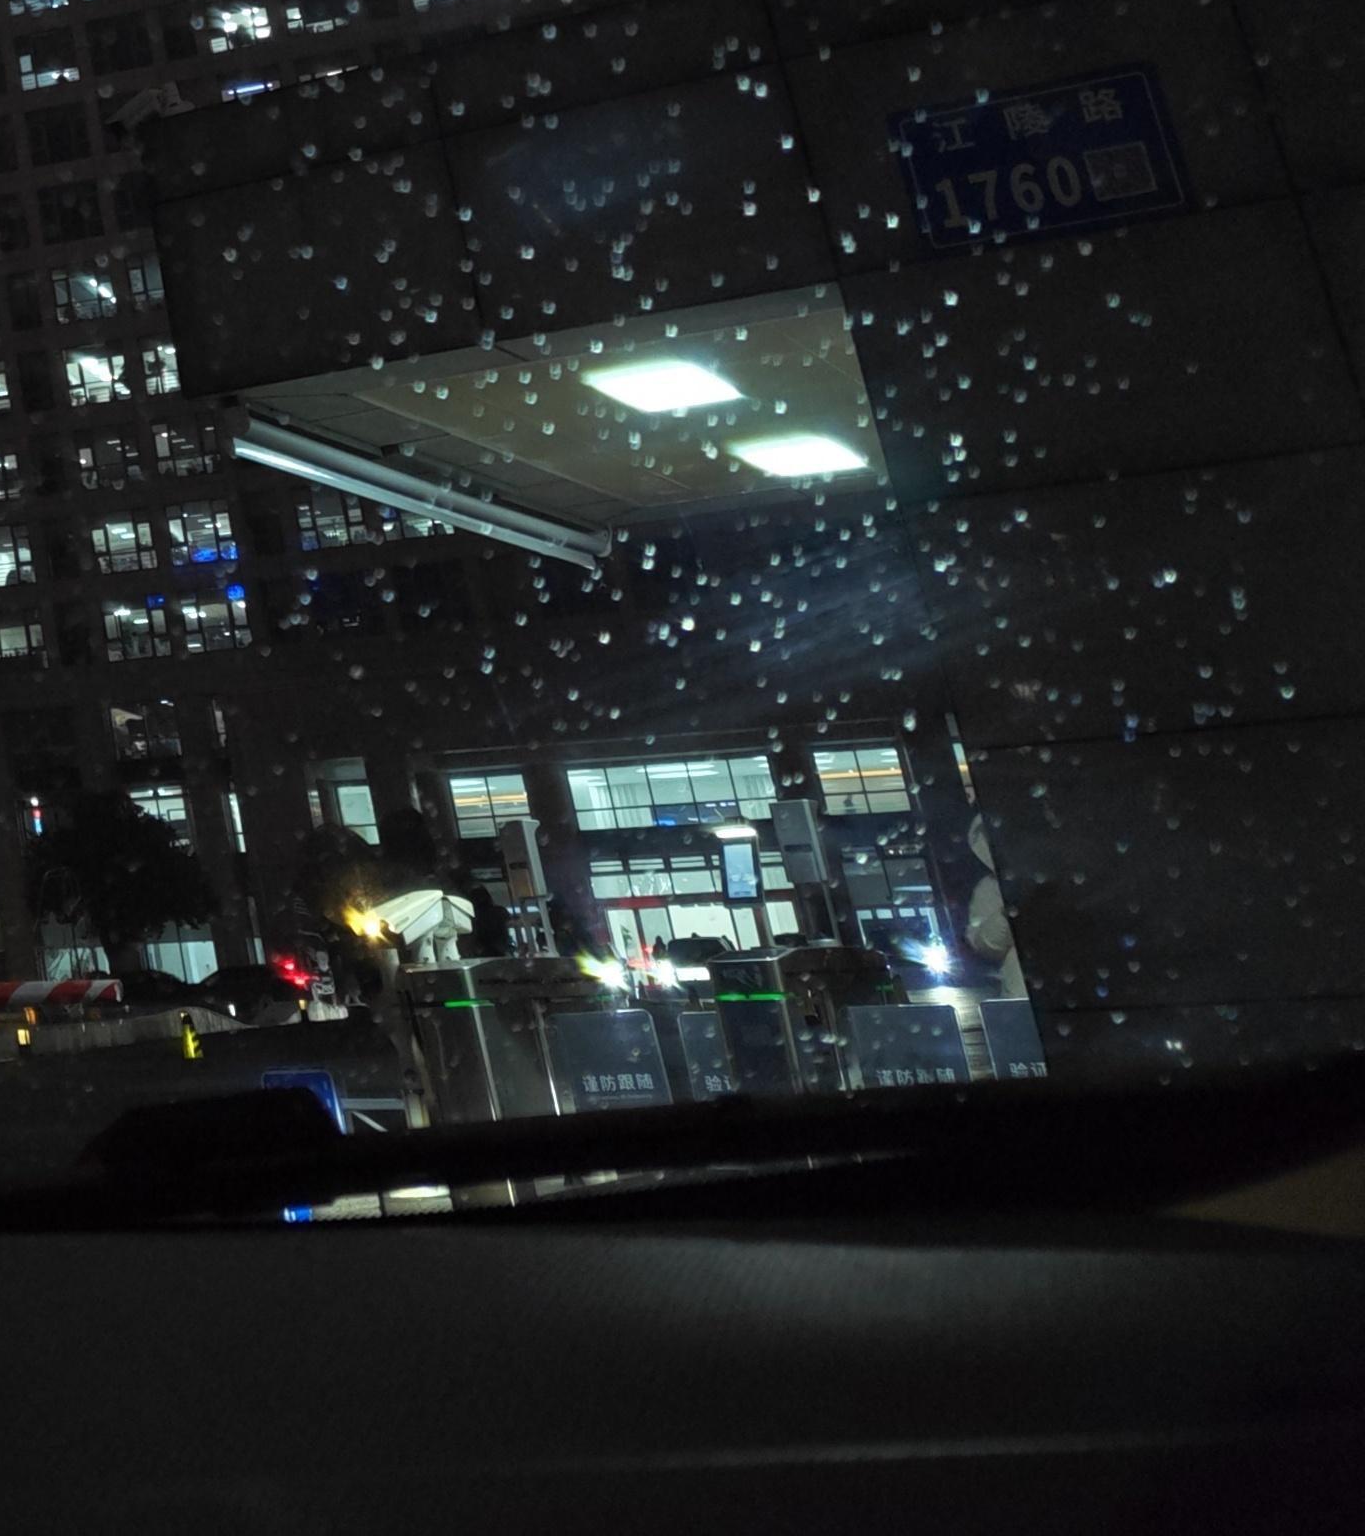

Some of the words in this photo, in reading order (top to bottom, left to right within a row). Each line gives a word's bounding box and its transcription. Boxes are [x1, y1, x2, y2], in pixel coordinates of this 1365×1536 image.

[931, 86, 1126, 154] 江陵路
[934, 156, 1083, 229] 1760
[581, 1072, 655, 1093] 谨防跟随
